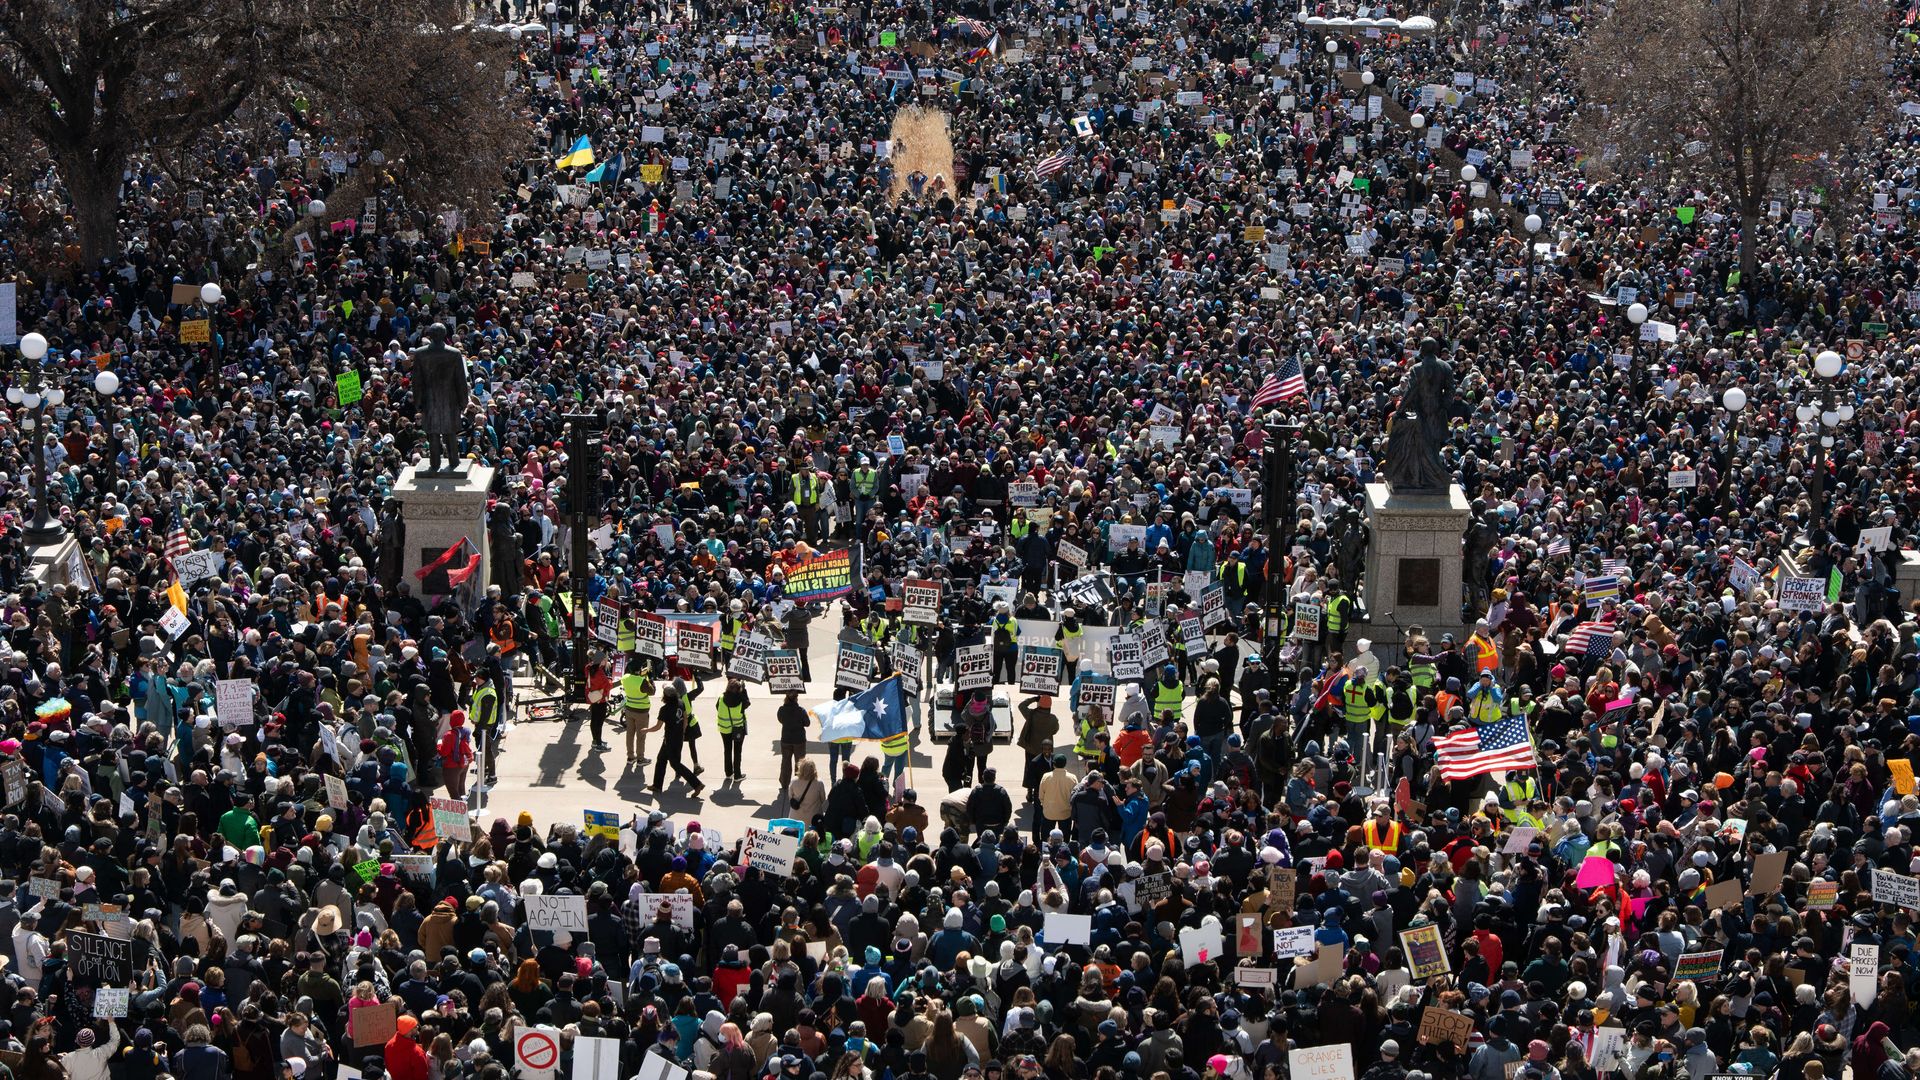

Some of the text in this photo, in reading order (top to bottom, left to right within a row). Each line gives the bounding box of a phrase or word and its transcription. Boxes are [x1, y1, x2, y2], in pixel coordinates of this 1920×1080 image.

[175, 554, 211, 568] Project
[907, 588, 937, 597] HANDS
[1785, 581, 1814, 592] PEOPLE
[907, 594, 938, 607] OFF!
[1204, 589, 1223, 601] HANDS
[1782, 591, 1822, 601] STRONGER
[1204, 598, 1224, 613] OFF!
[1297, 606, 1318, 614] NO
[601, 605, 618, 621] HANDS
[1297, 613, 1318, 622] KINGS
[601, 613, 618, 629] OFF!
[638, 618, 663, 632] HANDS
[1181, 619, 1199, 629] HANDS
[1296, 620, 1318, 629] NO
[638, 626, 663, 642] OFF!
[681, 630, 708, 641] HANDS
[1141, 627, 1162, 640] ANDS
[1183, 625, 1202, 639] OFF!
[681, 637, 709, 651] OFF!
[739, 638, 768, 651] HANDS
[1113, 642, 1140, 651] HANDS
[768, 656, 797, 665] HANDS
[842, 649, 871, 663] HANDS
[897, 651, 920, 665] HANDS
[961, 652, 991, 663] HANDS
[1026, 654, 1057, 664] HANDS
[1113, 650, 1140, 663] OFF!
[733, 665, 758, 678] WORKERS
[736, 659, 758, 671] FEDERAL
[769, 663, 799, 676] OFF!
[841, 657, 870, 676] OFF!
[896, 659, 919, 679] OFF!
[960, 661, 991, 673] OFF!
[1026, 662, 1057, 675] OFF!
[1116, 667, 1142, 677] SCIENCE
[788, 682, 804, 690] LANDS
[839, 674, 869, 688] IMMIGRANTS
[960, 676, 991, 687] VETERANS
[1023, 681, 1058, 691] CIVIL RIGHTS
[1082, 684, 1113, 693] HANDS
[1081, 691, 1113, 704] OFF!
[7, 764, 21, 776] TAX
[9, 780, 21, 790] THE
[8, 788, 24, 804] RICH
[747, 828, 781, 846] MORONS
[747, 837, 765, 849] ARE
[744, 847, 788, 867] GOVERNING
[538, 896, 570, 910] NOT
[529, 909, 586, 928] AGAIN
[71, 935, 126, 962] SILENCE
[1276, 941, 1295, 951] NOT
[1858, 947, 1873, 957] DUE
[91, 957, 103, 966] not
[1852, 957, 1878, 966] PROCESS
[79, 960, 121, 982] OPTION
[1855, 966, 1874, 975] NOW
[1423, 1010, 1466, 1031] STOP
[1298, 1050, 1343, 1066] ORANGE
[1311, 1064, 1336, 1076] LIES
